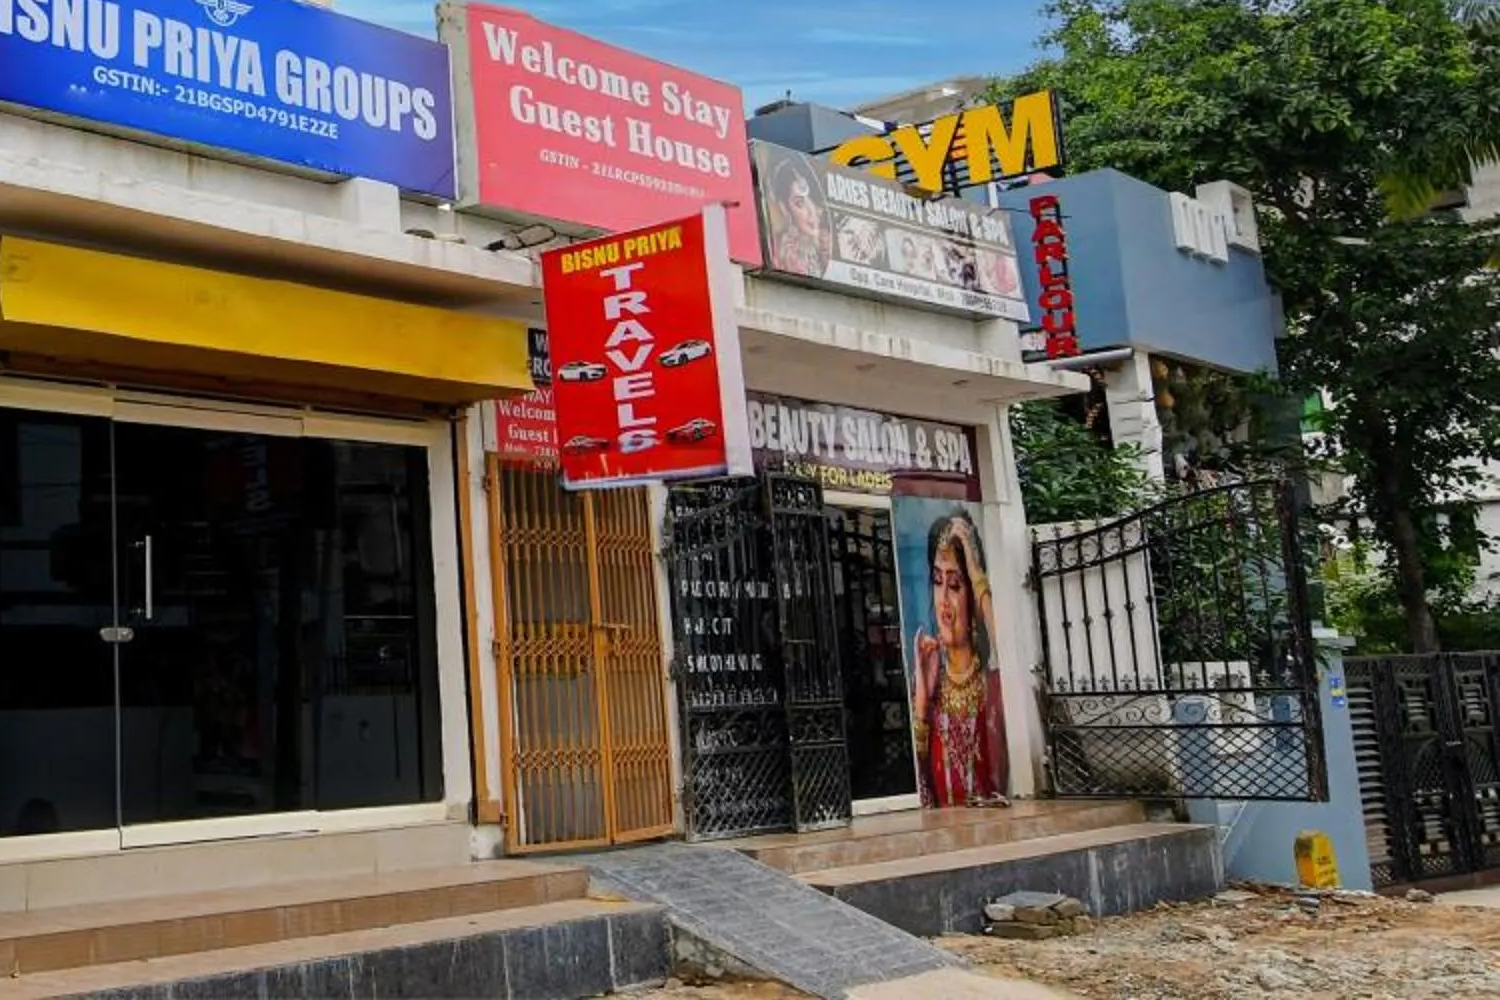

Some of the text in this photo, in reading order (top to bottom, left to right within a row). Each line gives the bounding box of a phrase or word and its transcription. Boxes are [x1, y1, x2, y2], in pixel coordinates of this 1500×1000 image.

[94, 65, 169, 97] GSTIN:-
[133, 11, 265, 97] PRIYA
[275, 48, 437, 140] GROUPS
[482, 21, 731, 139] Welcome Stay
[509, 85, 731, 178] Guest House
[829, 88, 1059, 193] GYM
[870, 184, 924, 225] BEAUTY
[925, 201, 970, 238] SALON
[561, 226, 683, 275] BISNU PRIYA
[600, 262, 658, 454] TRAVELS
[499, 400, 556, 421] Welcom
[508, 424, 549, 444] Guest
[751, 400, 973, 475] BEAUTY SALON & SPA
[820, 465, 848, 486] FOR
